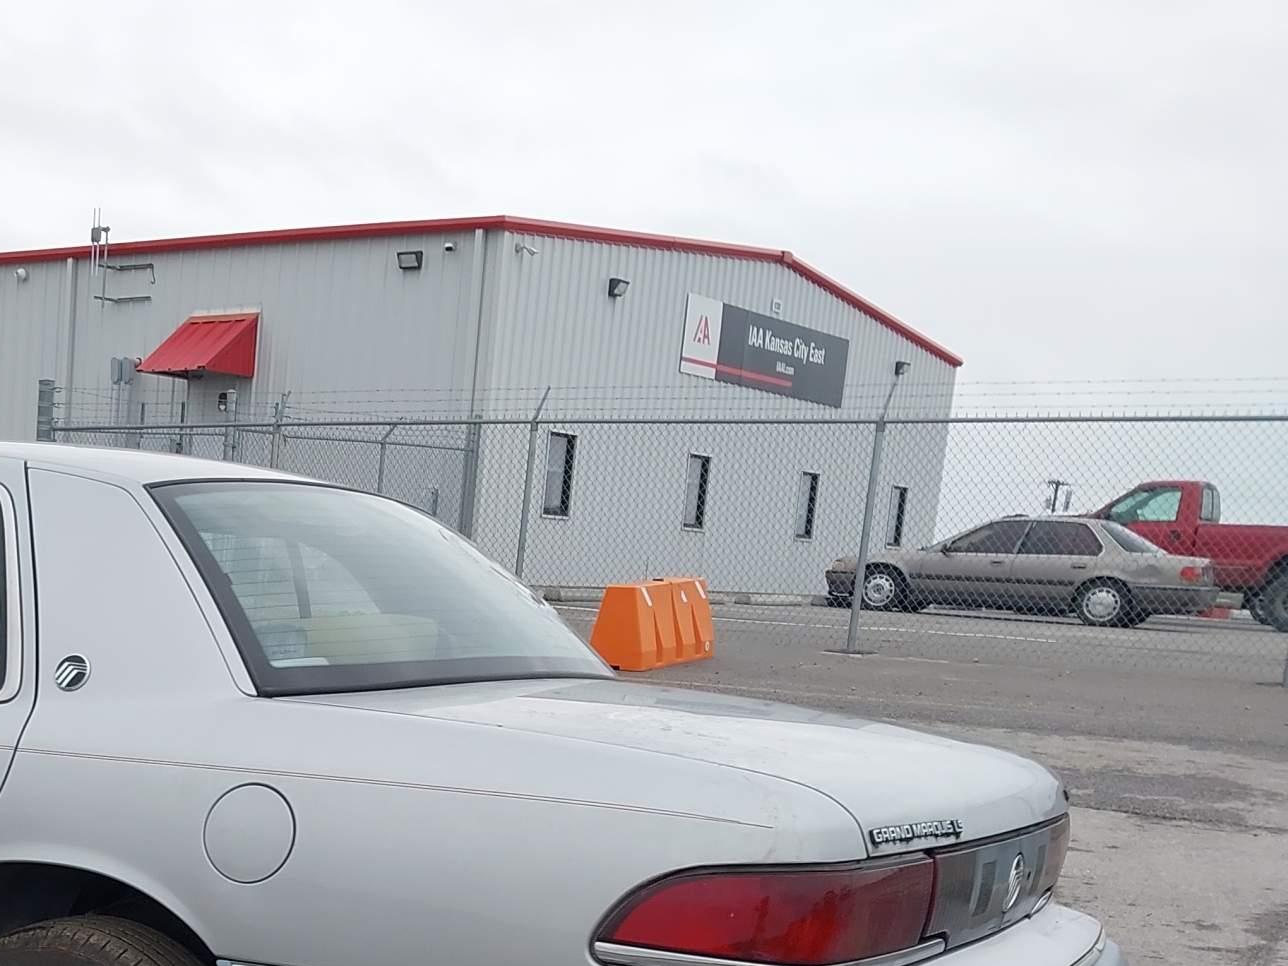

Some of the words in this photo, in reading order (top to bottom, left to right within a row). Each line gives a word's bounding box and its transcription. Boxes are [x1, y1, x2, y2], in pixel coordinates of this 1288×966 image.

[748, 325, 764, 349] IAA
[765, 329, 792, 356] Kansas
[793, 337, 809, 365] City
[809, 342, 826, 365] East
[872, 824, 912, 843] GRAND
[912, 820, 953, 837] MARQUIS
